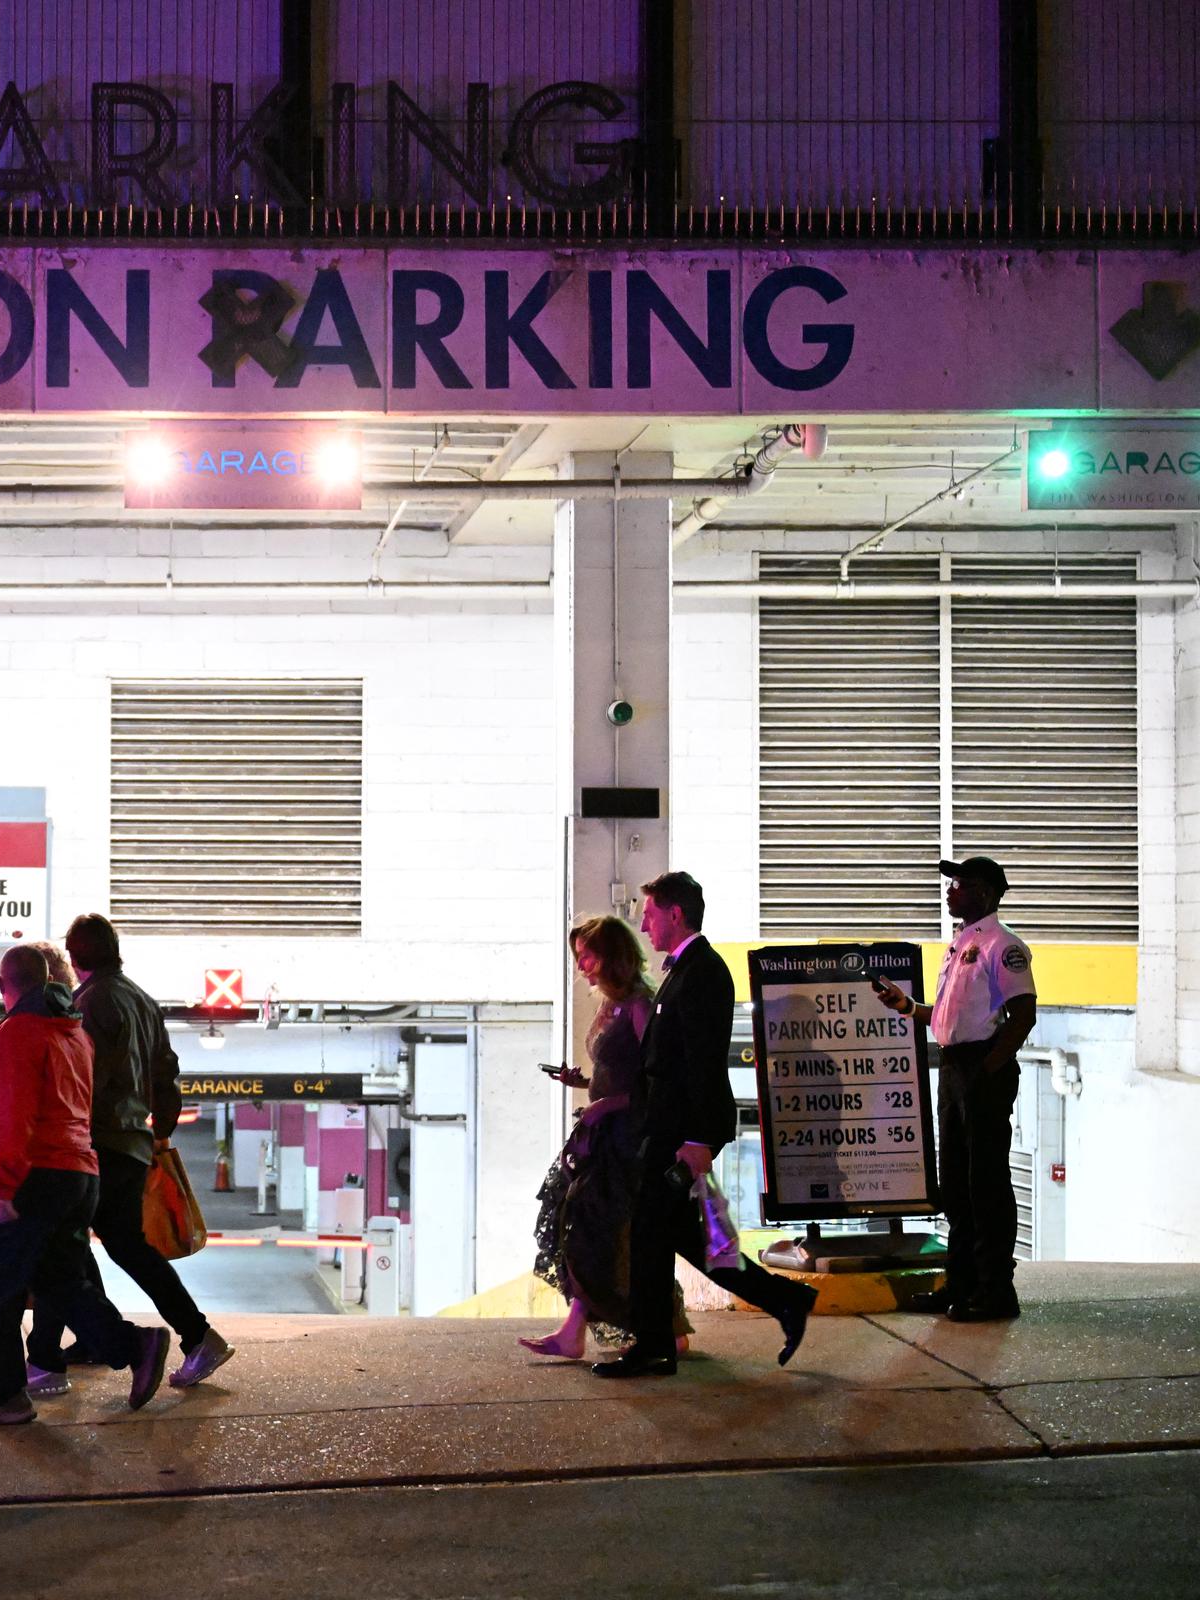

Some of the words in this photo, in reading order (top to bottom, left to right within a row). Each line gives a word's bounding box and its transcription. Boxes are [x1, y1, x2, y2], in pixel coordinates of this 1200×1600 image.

[210, 266, 854, 391] PARKING
[176, 450, 306, 476] ARAG
[1074, 451, 1200, 474] GARAG
[759, 956, 837, 974] Washington
[869, 955, 911, 968] Hilton
[815, 993, 857, 1013] SELF
[769, 1019, 847, 1040] PARKING
[856, 1017, 908, 1038] RATES
[773, 1060, 790, 1077] 15
[882, 1056, 910, 1074] $20
[180, 1079, 264, 1094] EARANCE
[776, 1095, 801, 1112] 1-2
[806, 1093, 863, 1111] HOURS
[885, 1091, 913, 1108] $28
[778, 1130, 814, 1146] 2-24
[819, 1127, 877, 1145] HOURS
[887, 1126, 915, 1143] $56
